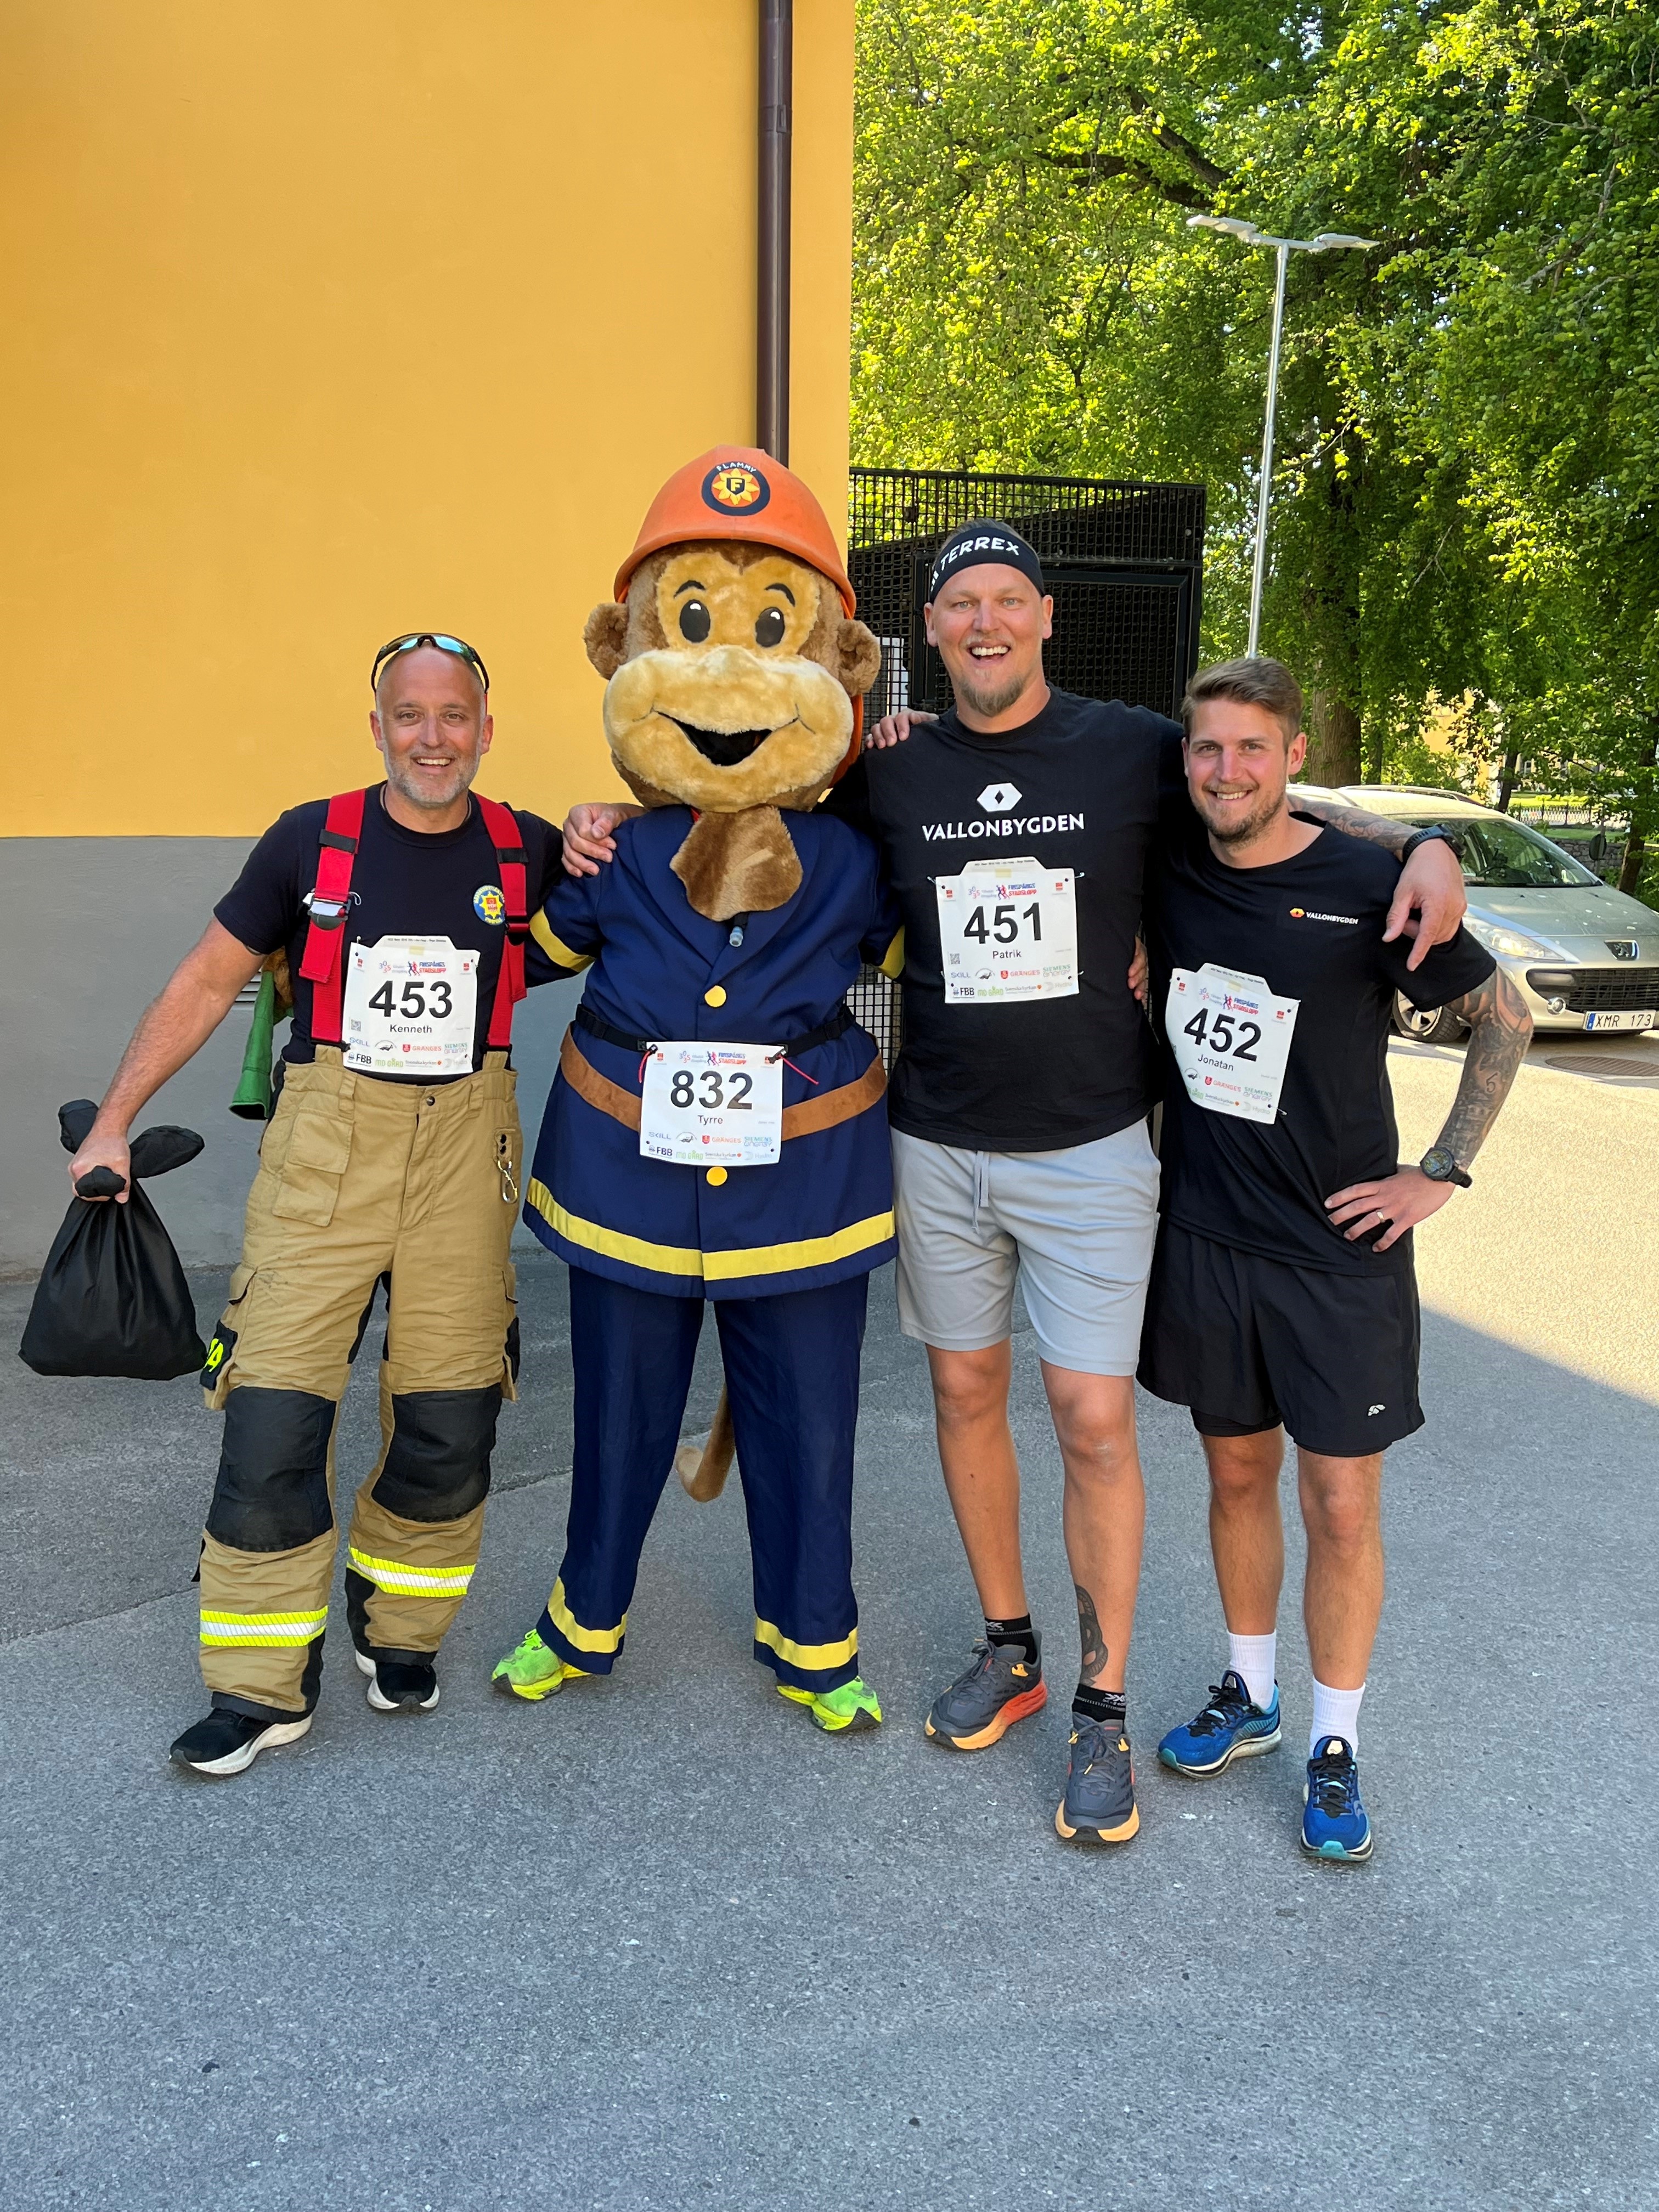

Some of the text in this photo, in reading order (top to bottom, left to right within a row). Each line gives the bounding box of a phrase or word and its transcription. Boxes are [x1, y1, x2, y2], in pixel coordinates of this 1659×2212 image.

[716, 461, 757, 472] FLAMMY
[730, 478, 743, 492] F
[940, 536, 1019, 571] TERREX
[922, 812, 1085, 842] VALLONBYGDEN
[964, 902, 1042, 945] 451
[1306, 911, 1359, 924] VALLONBYGDEN
[992, 950, 1022, 959] Patrik
[960, 987, 974, 996] FBB
[368, 980, 453, 1019] 453
[1595, 1014, 1620, 1028] XMR
[1630, 1014, 1652, 1027] 173
[390, 1024, 432, 1034] Kenneth
[1183, 1008, 1262, 1062] 452
[356, 1053, 372, 1064] FBB
[1198, 1054, 1234, 1071] Jonatan
[670, 1070, 753, 1110] 832
[1244, 1086, 1273, 1097] SIEMENS
[697, 1115, 723, 1125] Tyrre
[657, 1147, 673, 1156] FBB
